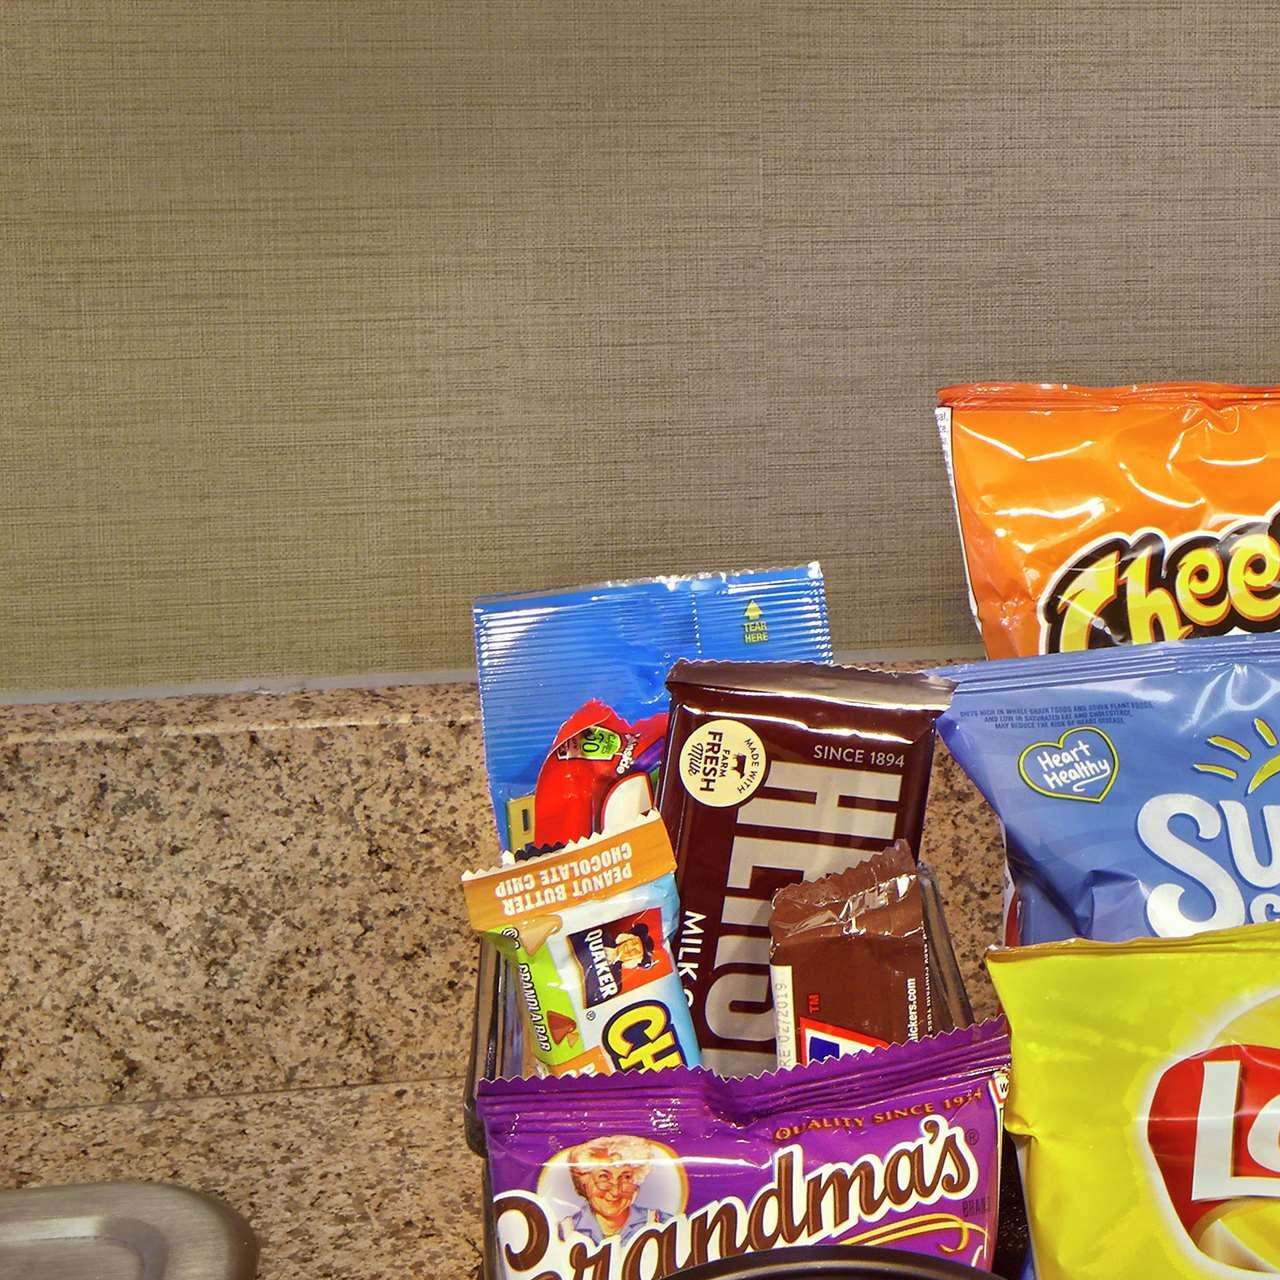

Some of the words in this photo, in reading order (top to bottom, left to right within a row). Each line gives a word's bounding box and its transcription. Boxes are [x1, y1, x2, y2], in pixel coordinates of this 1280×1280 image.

[687, 743, 704, 776] Milk
[699, 730, 723, 793] FRESH
[718, 749, 731, 778] FARM
[813, 745, 865, 764] SINCE
[869, 752, 905, 768] 1894
[1036, 739, 1092, 772] Heart
[1042, 758, 1111, 790] Healthy
[540, 842, 633, 880] CHOCOLATE
[494, 876, 536, 899] CHIP
[572, 861, 634, 898] PEANUT
[501, 882, 567, 916] BUTTER
[676, 909, 707, 982] MILK
[583, 928, 620, 1001] QUAKER
[533, 1022, 552, 1053] BAR
[775, 1116, 865, 1142] QUALITY
[872, 1103, 936, 1124] SINCE
